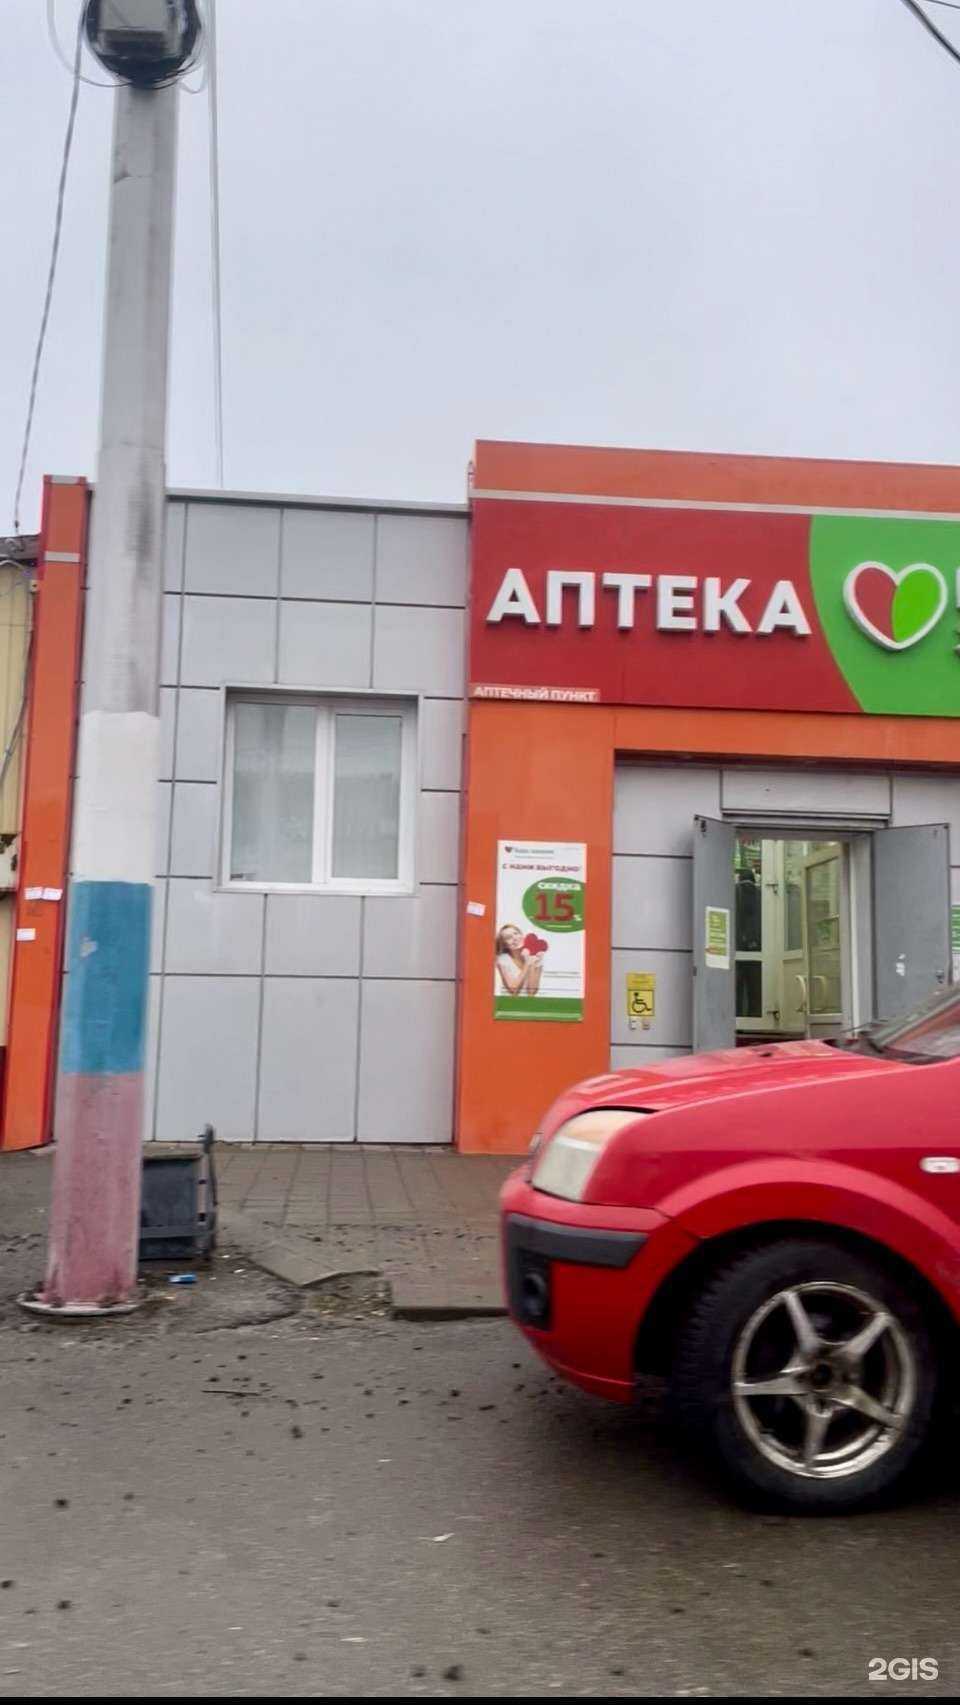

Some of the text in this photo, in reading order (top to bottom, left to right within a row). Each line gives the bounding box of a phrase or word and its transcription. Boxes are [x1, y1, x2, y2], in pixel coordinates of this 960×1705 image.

[486, 567, 812, 637] АПТЕКА
[473, 685, 597, 702] АПТЕЧНЫЙ ПУНКТ
